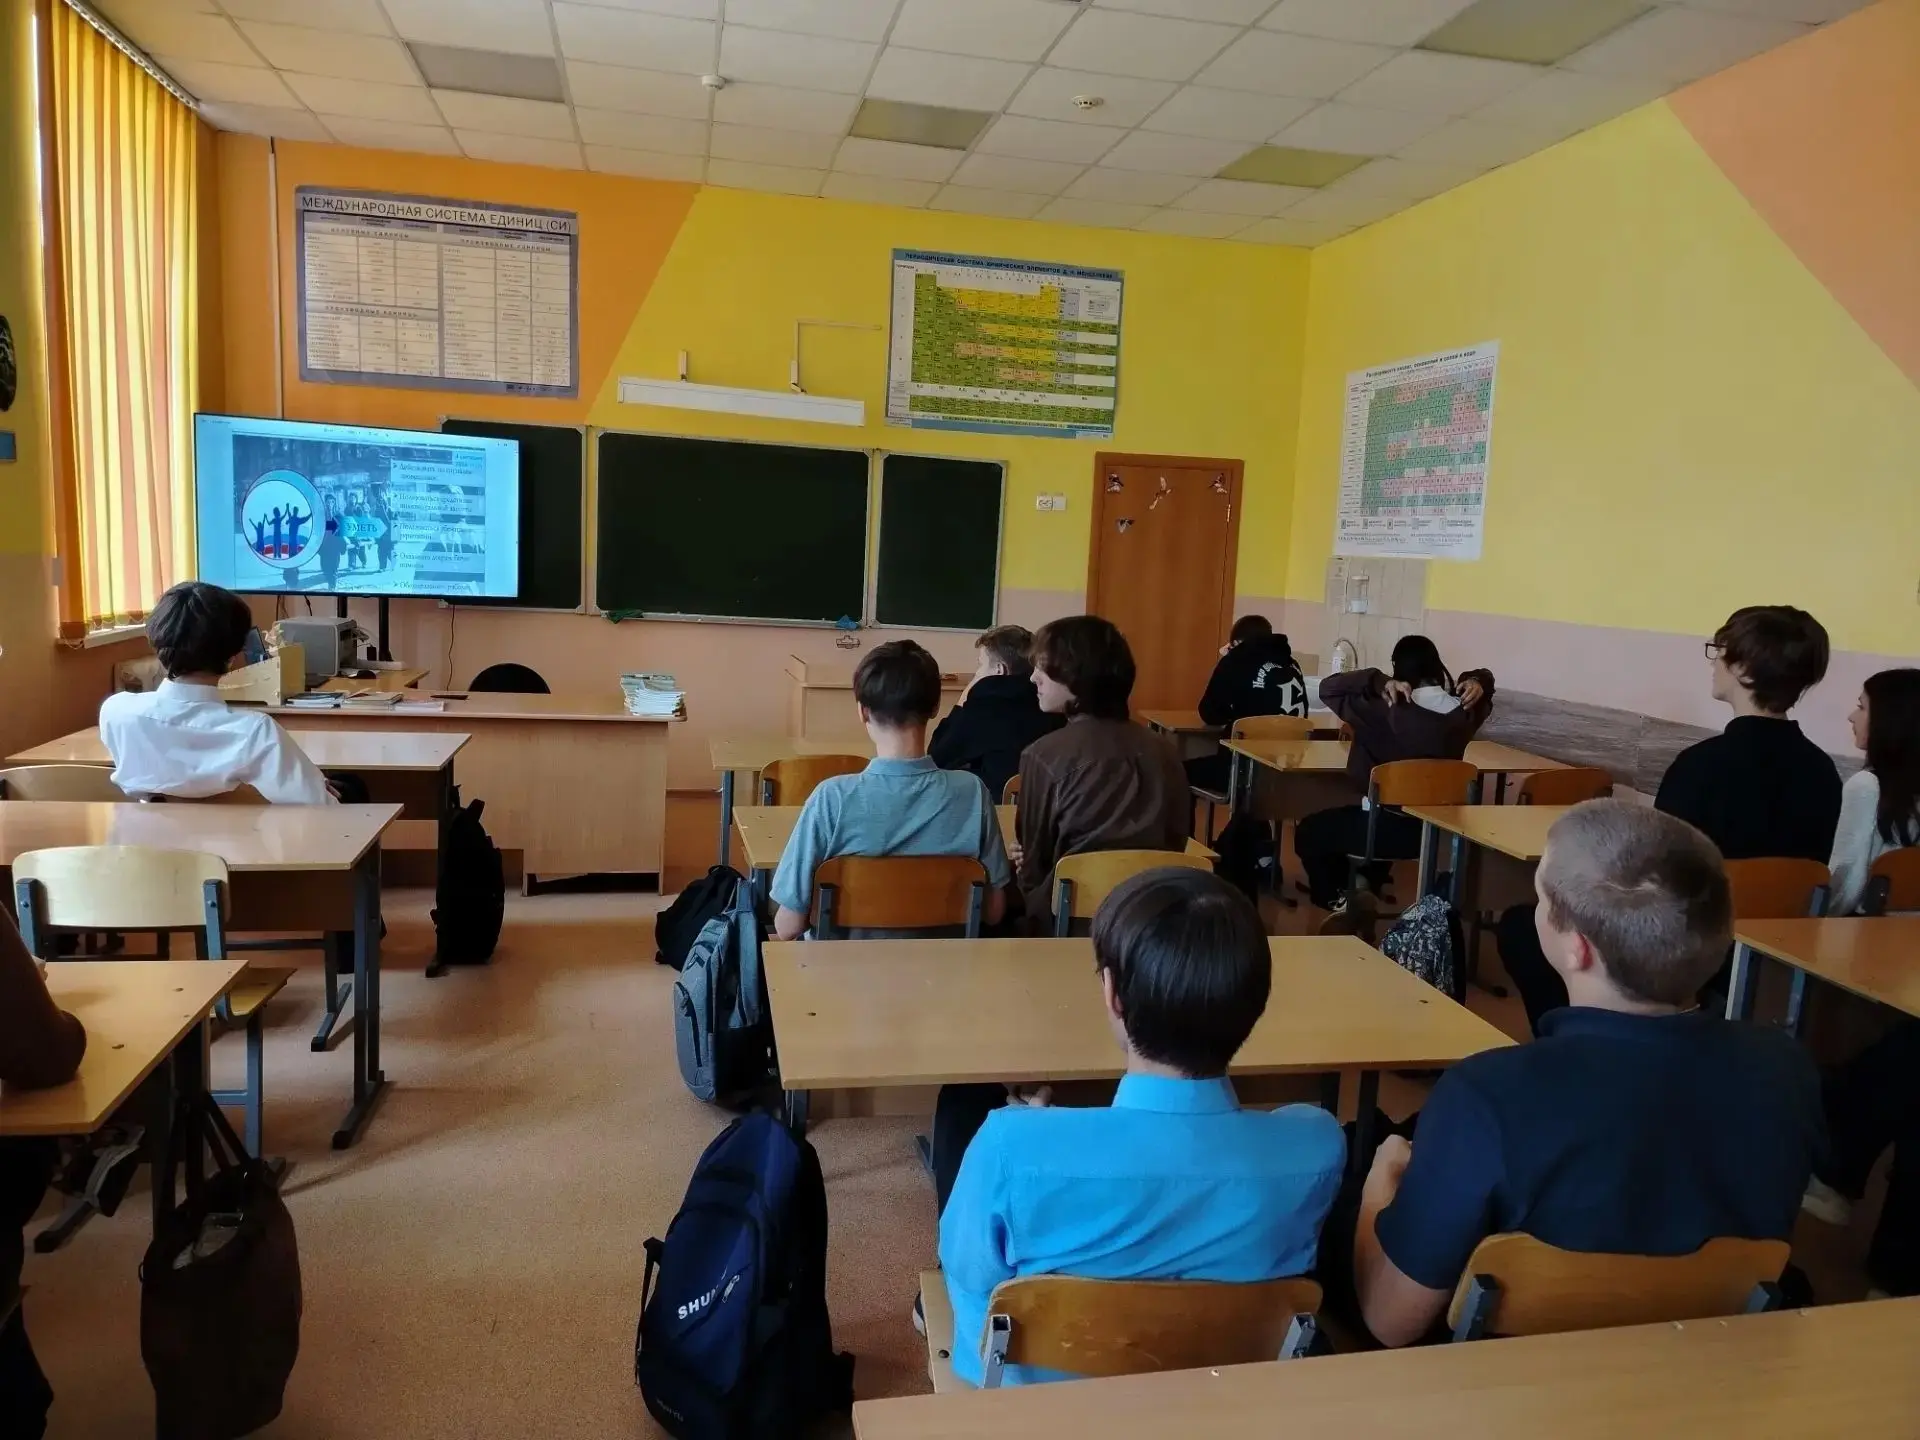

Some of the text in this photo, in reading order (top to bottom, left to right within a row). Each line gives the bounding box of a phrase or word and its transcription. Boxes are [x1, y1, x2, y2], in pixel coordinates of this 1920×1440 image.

[302, 196, 422, 217] МЕЖДУНАРОДНАЯ
[425, 207, 487, 225] СИСТЕМА
[490, 214, 543, 231] ЕДИНИЦ
[546, 219, 571, 233] (СИ)
[957, 258, 984, 267] СИСТЕМА
[346, 522, 378, 532] УМЕТЬ
